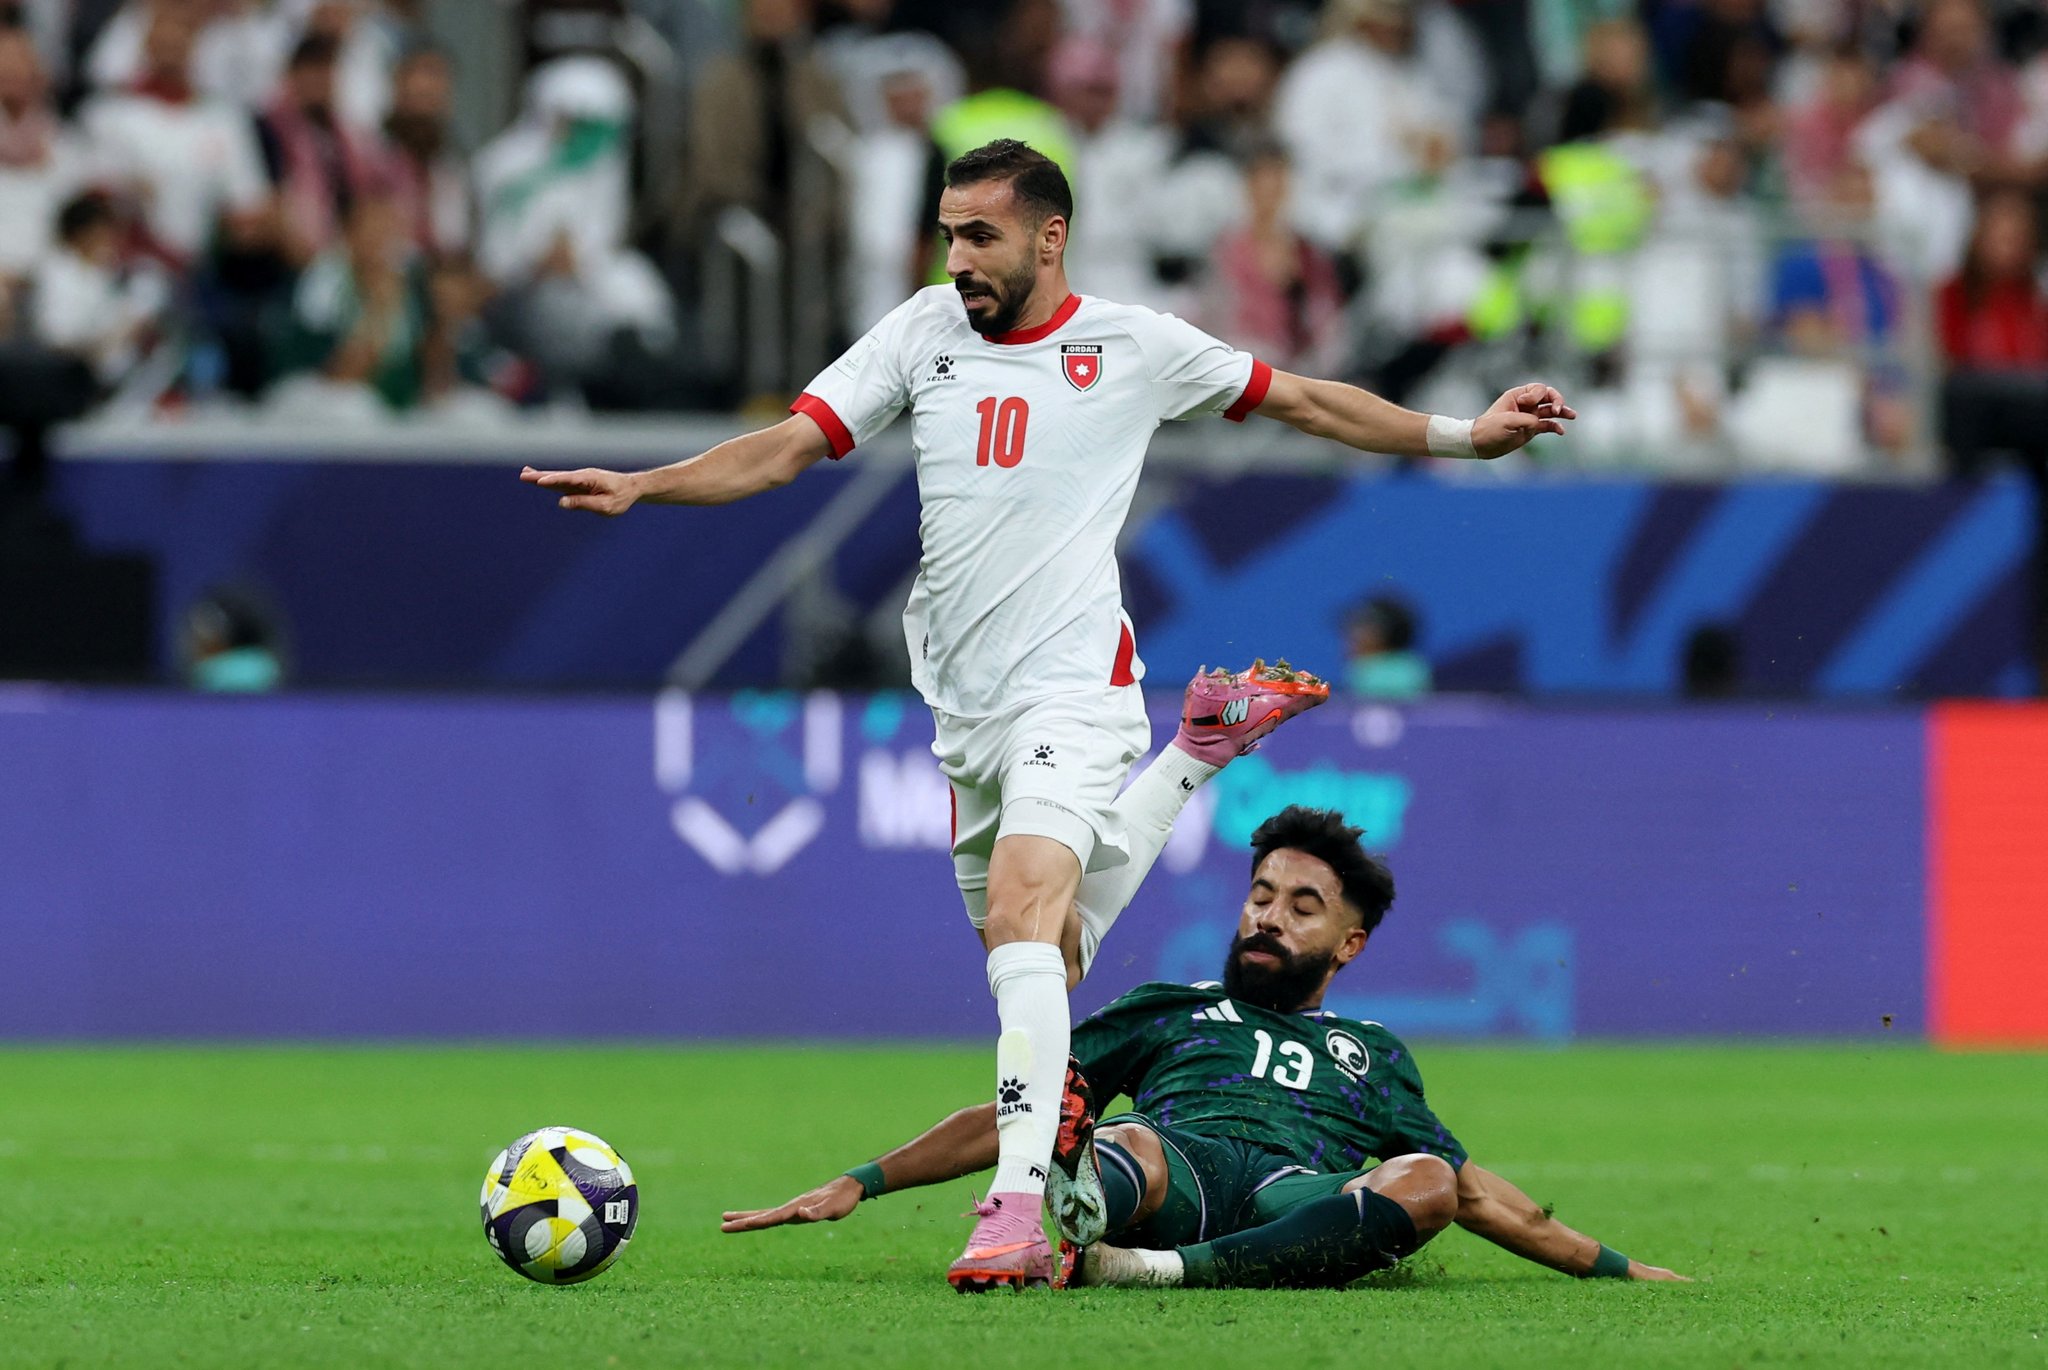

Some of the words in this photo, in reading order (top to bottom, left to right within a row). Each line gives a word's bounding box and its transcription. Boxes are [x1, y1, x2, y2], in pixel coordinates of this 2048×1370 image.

[926, 374, 957, 382] KELME
[976, 396, 1029, 468] 10
[1023, 760, 1058, 769] KELME
[1250, 1029, 1314, 1090] 13
[1334, 1063, 1357, 1083] SAUDI
